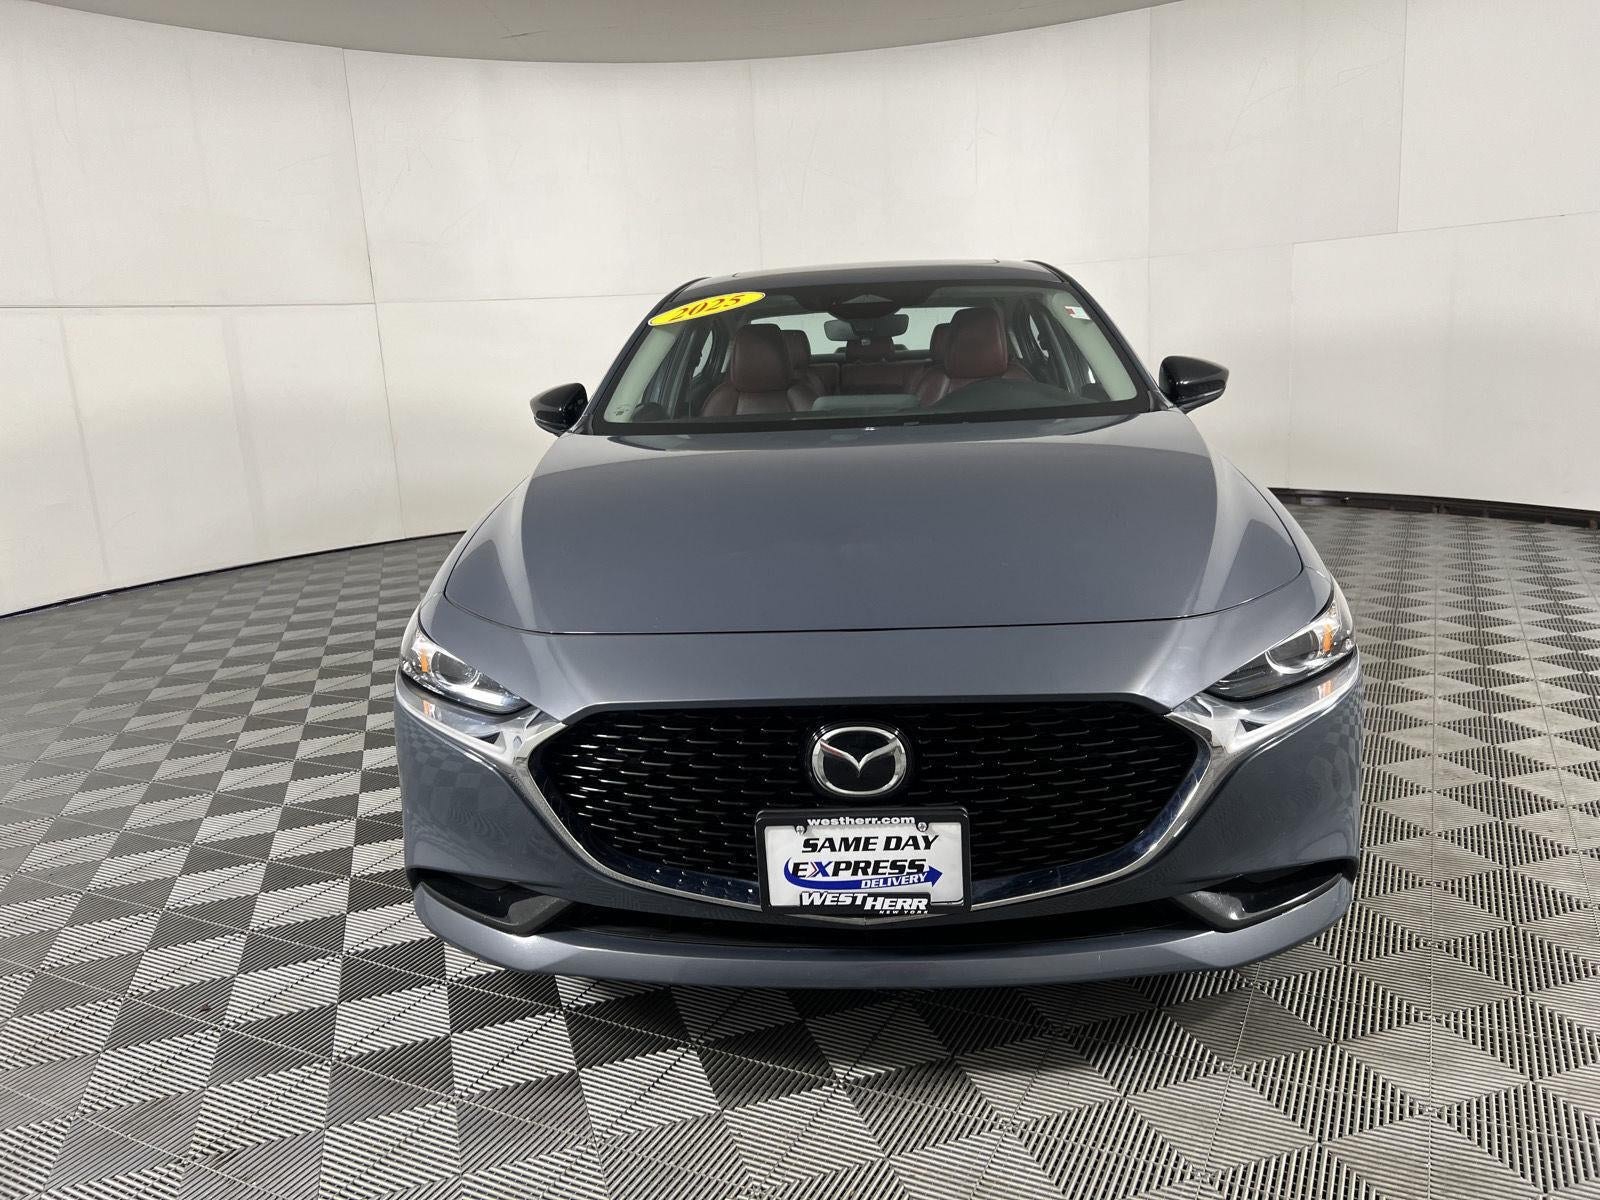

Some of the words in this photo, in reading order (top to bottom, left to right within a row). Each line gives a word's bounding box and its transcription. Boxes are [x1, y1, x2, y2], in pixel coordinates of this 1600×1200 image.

[668, 294, 746, 322] 2025
[807, 816, 915, 826] westherr.com
[801, 836, 878, 853] SAME
[883, 835, 939, 851] DAY
[792, 858, 926, 878] EXPRESS
[861, 872, 928, 889] DELIVERY
